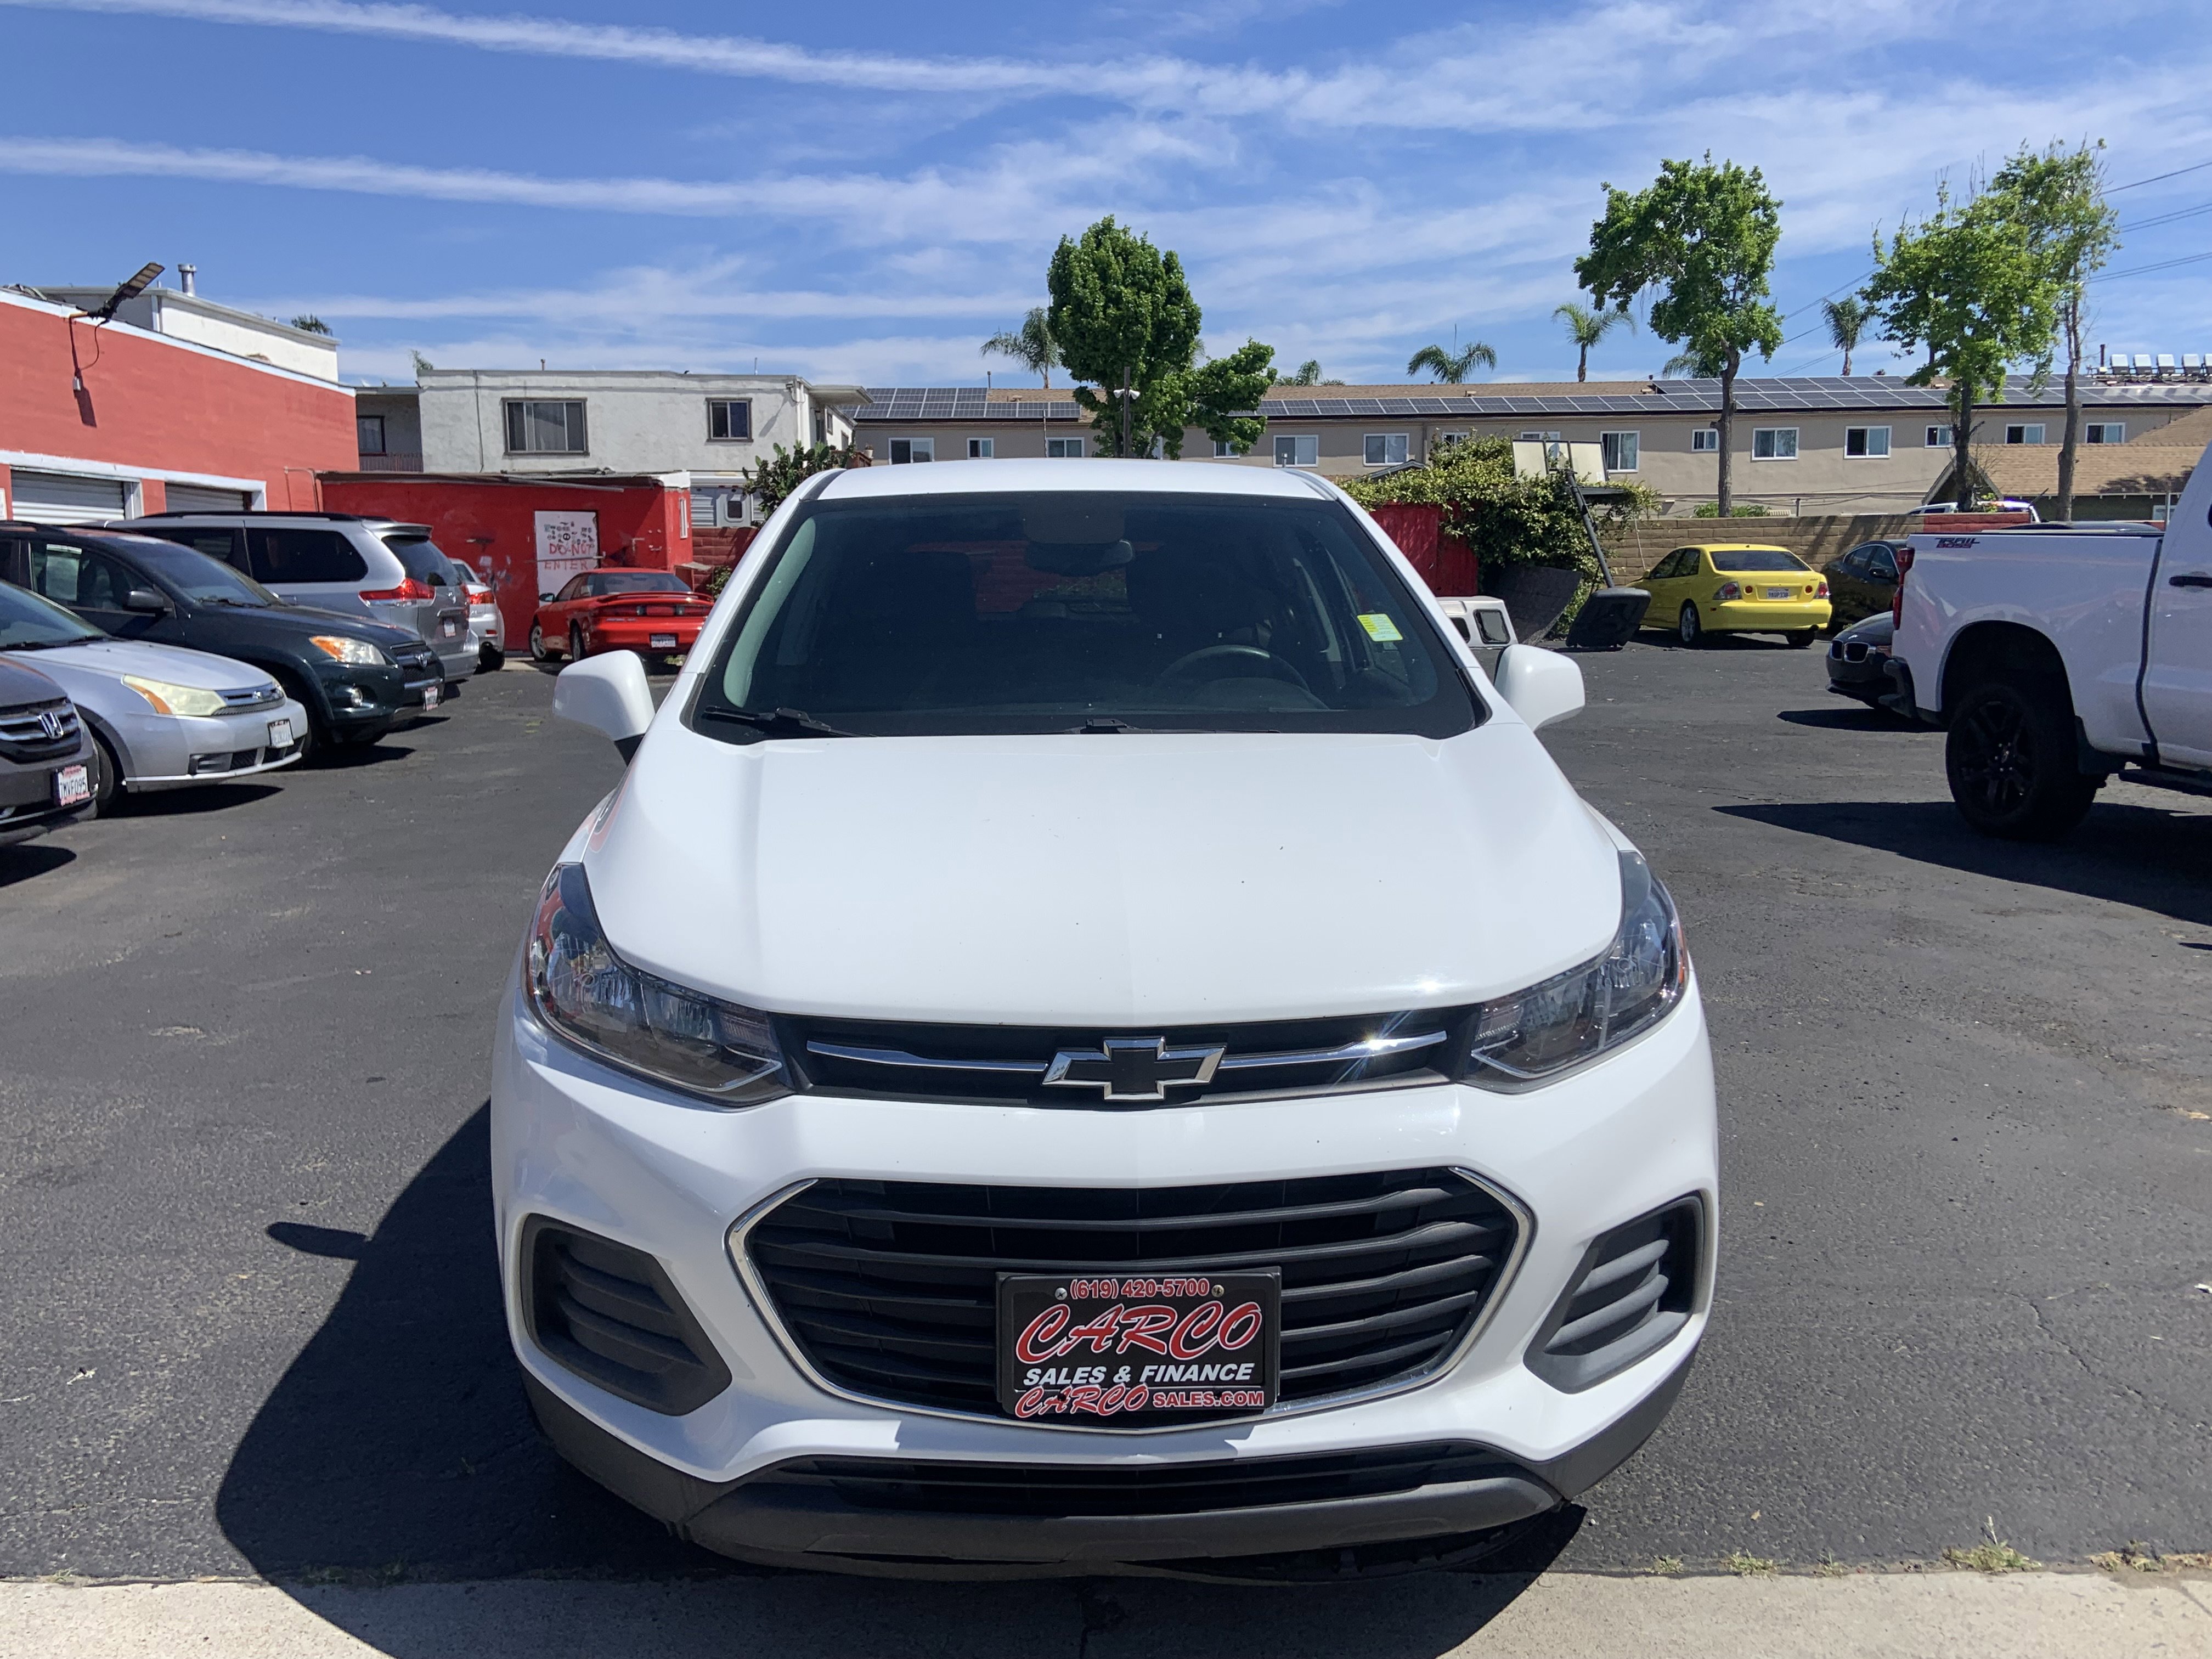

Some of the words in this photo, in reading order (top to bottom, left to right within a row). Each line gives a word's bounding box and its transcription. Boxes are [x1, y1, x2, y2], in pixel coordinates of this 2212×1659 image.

[544, 560, 588, 571] ENTER
[1070, 1279, 1118, 1299] (619)
[1121, 1278, 1210, 1298] 420-5700
[1016, 1300, 1262, 1364] CARCO
[1023, 1365, 1107, 1386] SALES
[1113, 1366, 1131, 1383] &
[1139, 1363, 1255, 1383] FINANCE
[1015, 1383, 1149, 1418] CARCO
[1153, 1391, 1264, 1408] SALES.COM
